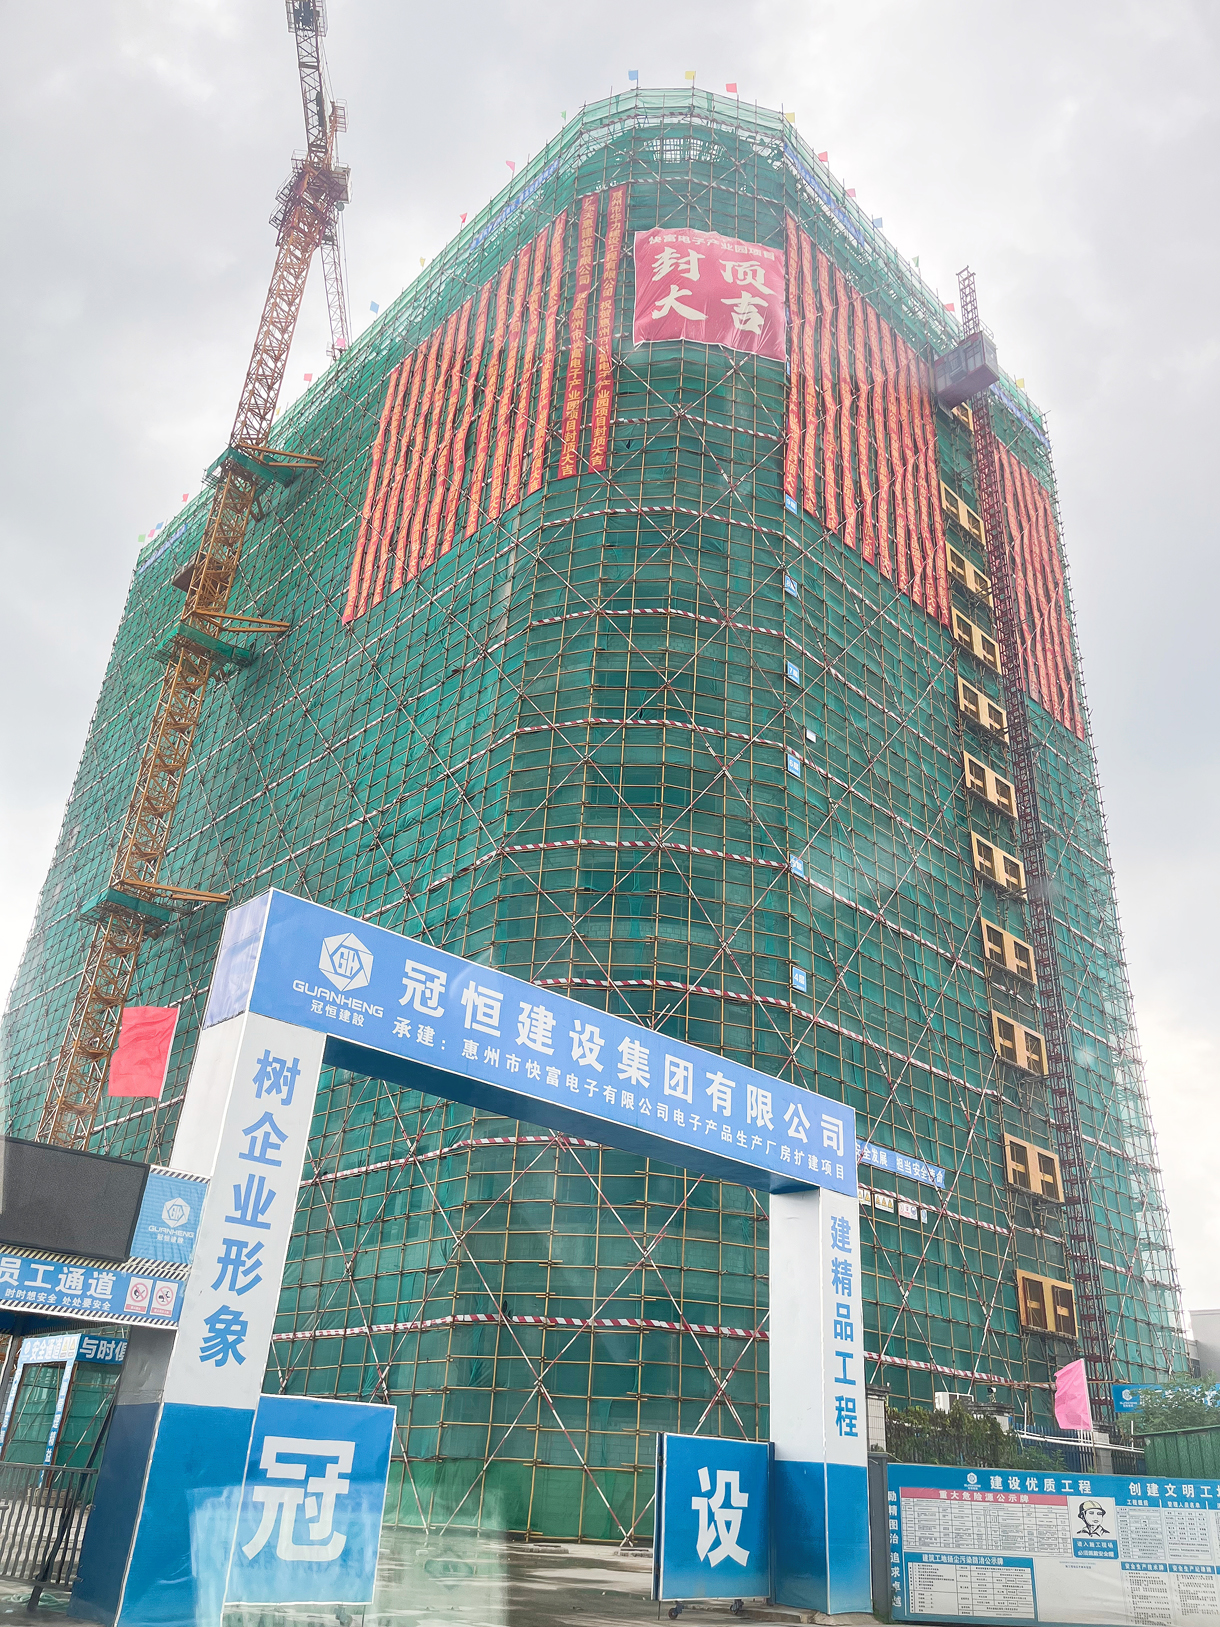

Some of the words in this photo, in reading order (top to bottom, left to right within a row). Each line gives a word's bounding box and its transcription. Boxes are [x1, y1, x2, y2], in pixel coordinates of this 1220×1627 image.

[649, 234, 775, 261] 快富电子产业园项目
[652, 247, 776, 294] 封顶
[651, 285, 769, 334] 大吉
[292, 979, 384, 1018] GUANHENG
[310, 999, 365, 1027] 冠恒建設
[398, 958, 845, 1157] 冠恒建设集团有限公司
[198, 1049, 301, 1367] 树企业形象
[148, 1225, 195, 1238] GUANHENG
[0, 1257, 117, 1299] 员工通道
[5, 1288, 58, 1304] 时时想安全
[61, 1297, 112, 1311] 处处要安全
[830, 1215, 859, 1438] 建精品工程
[242, 1436, 356, 1562] 冠
[938, 1490, 1029, 1503] 重大危险源公示牌
[990, 1475, 1092, 1495] 建设优质工程
[691, 1466, 750, 1568] 设
